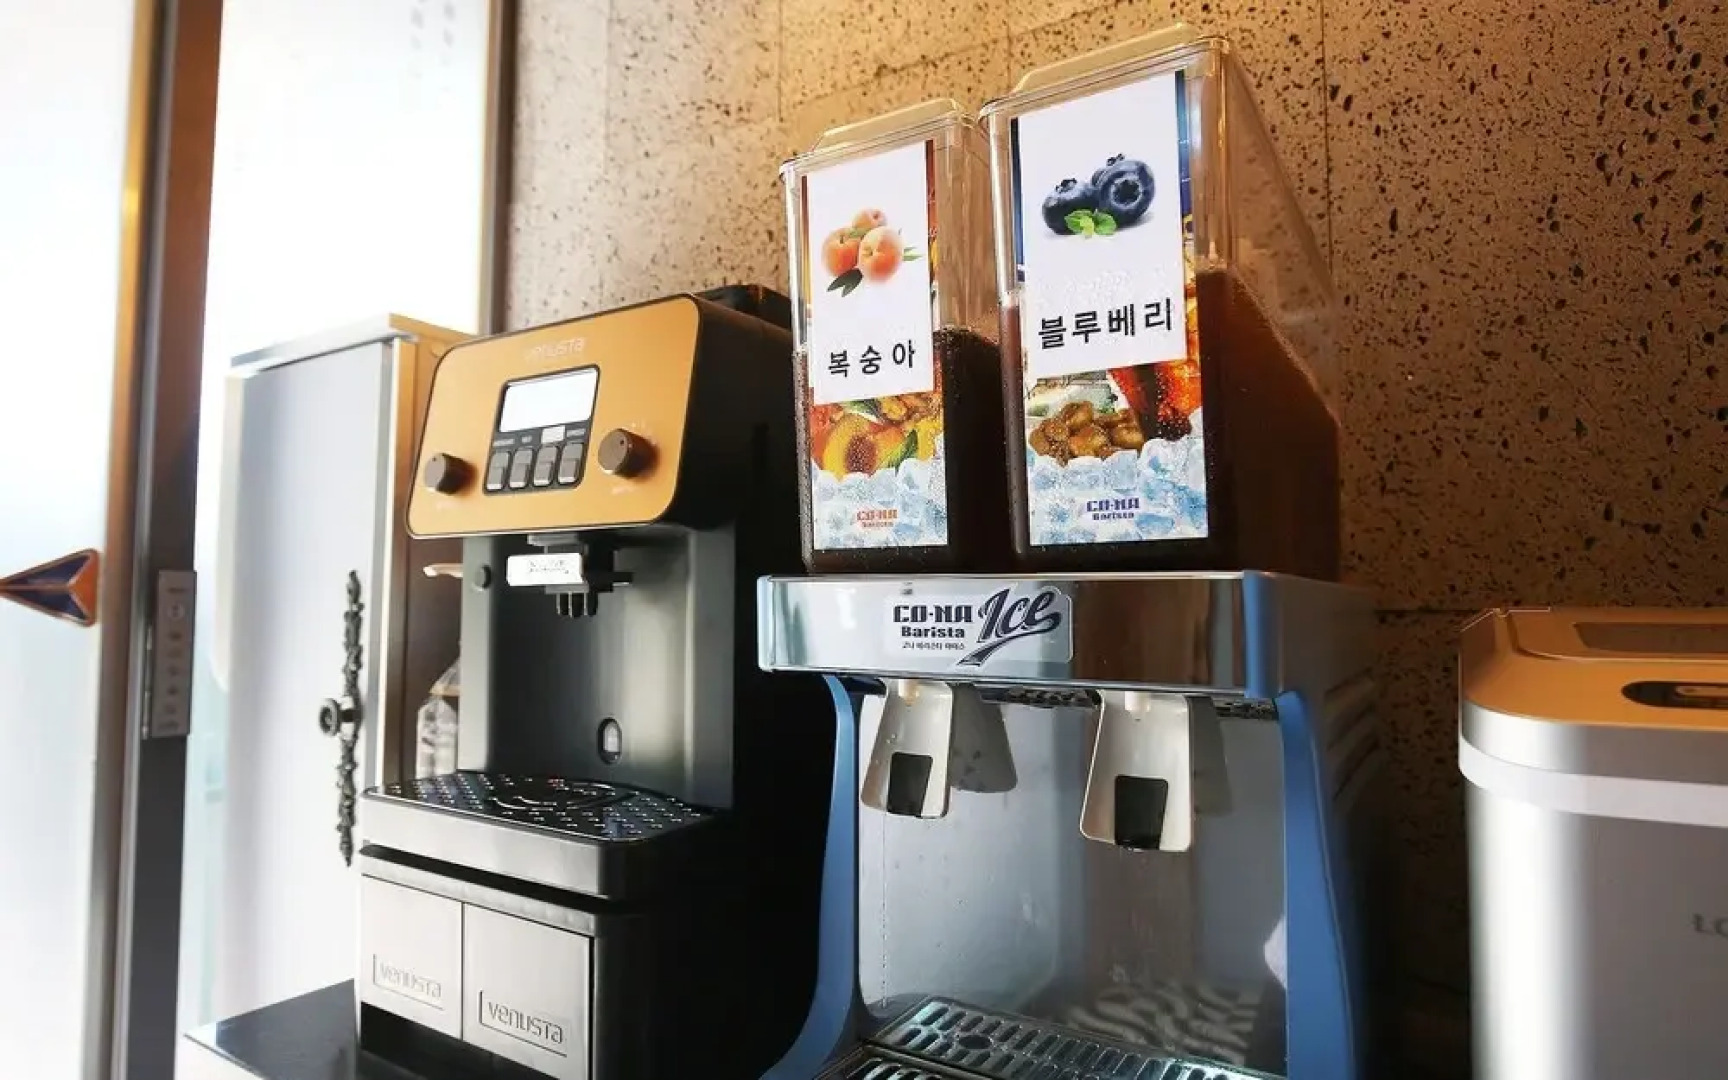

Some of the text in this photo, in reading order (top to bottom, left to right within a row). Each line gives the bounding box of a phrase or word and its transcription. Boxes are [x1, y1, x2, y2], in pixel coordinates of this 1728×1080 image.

[1038, 297, 1171, 350] 블루베리
[827, 338, 916, 378] 복숭아
[901, 626, 965, 638] Barista
[965, 587, 1062, 658] Ice
